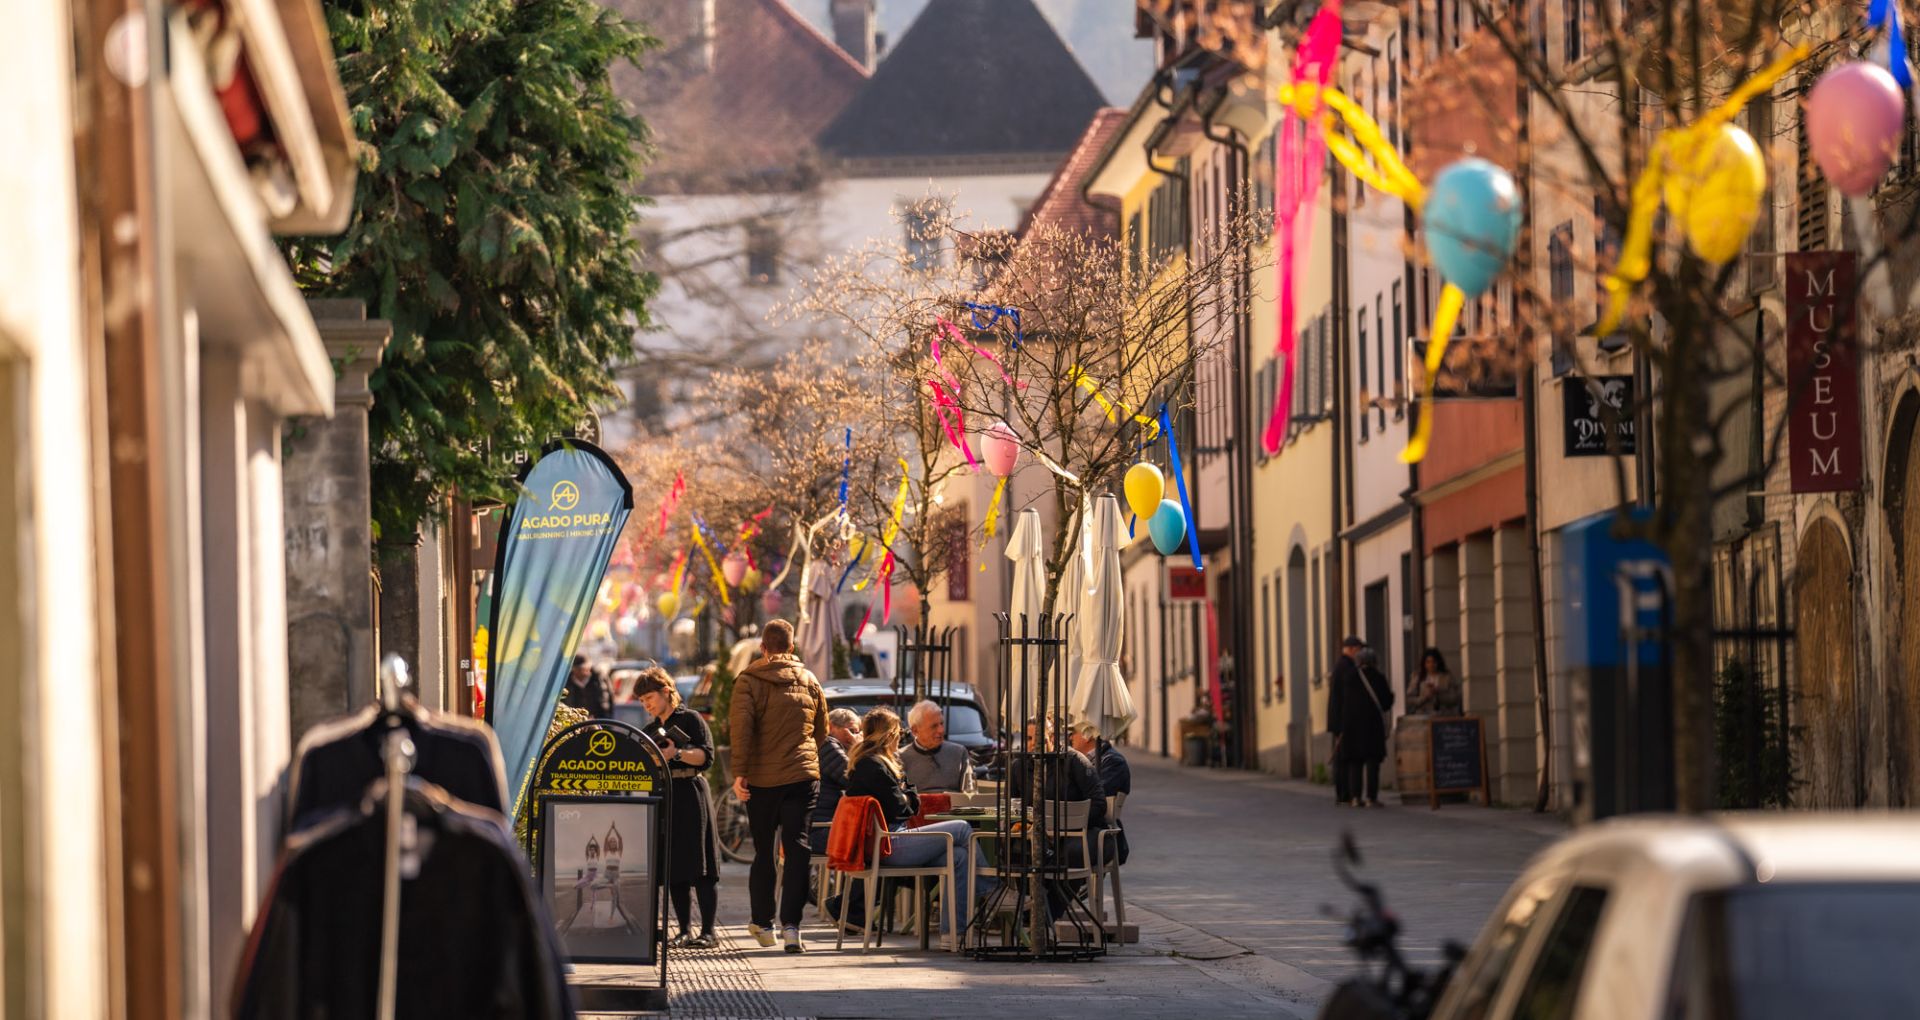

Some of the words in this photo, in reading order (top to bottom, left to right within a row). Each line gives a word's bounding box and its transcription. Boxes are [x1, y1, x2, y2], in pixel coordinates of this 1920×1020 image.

[1805, 268, 1842, 477] MUSEUM
[1573, 418, 1634, 441] DIVN
[521, 515, 570, 529] AGADO
[573, 512, 611, 527] PURA
[516, 530, 566, 540] RAILRUNNING
[558, 760, 607, 771] AGADO
[609, 761, 646, 772] PURA
[597, 781, 609, 790] 30
[611, 781, 641, 790] Meter
